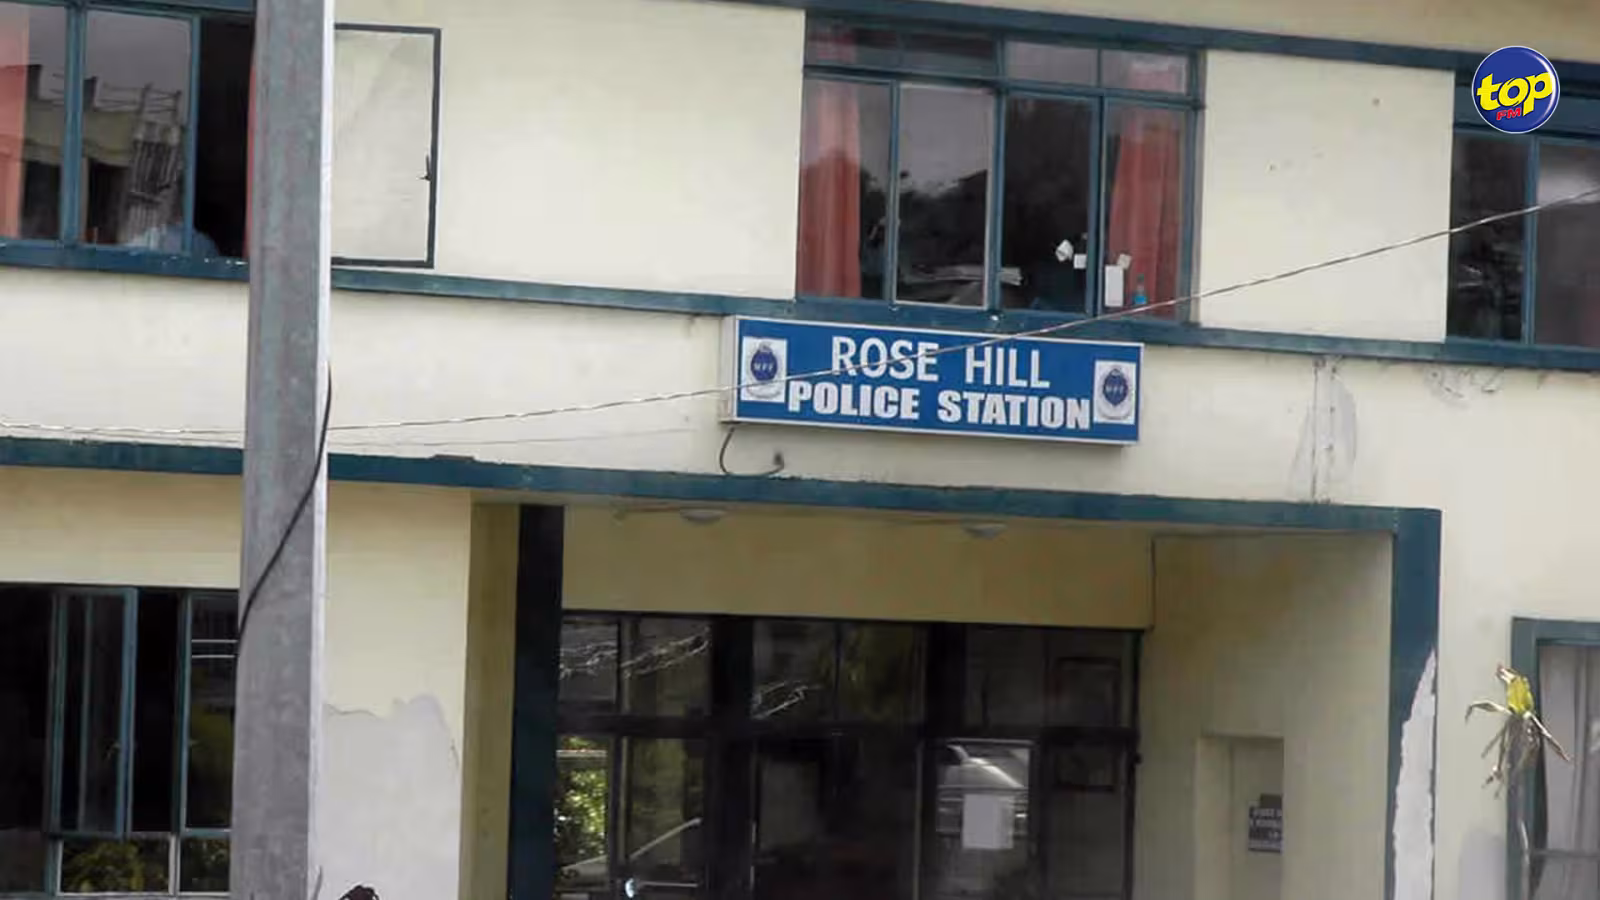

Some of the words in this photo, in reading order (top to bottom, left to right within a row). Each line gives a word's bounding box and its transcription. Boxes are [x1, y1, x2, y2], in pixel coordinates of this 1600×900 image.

[831, 336, 940, 382] ROSE
[965, 345, 1051, 388] HILL
[788, 380, 920, 420] POLICE
[938, 391, 1091, 430] STATION
